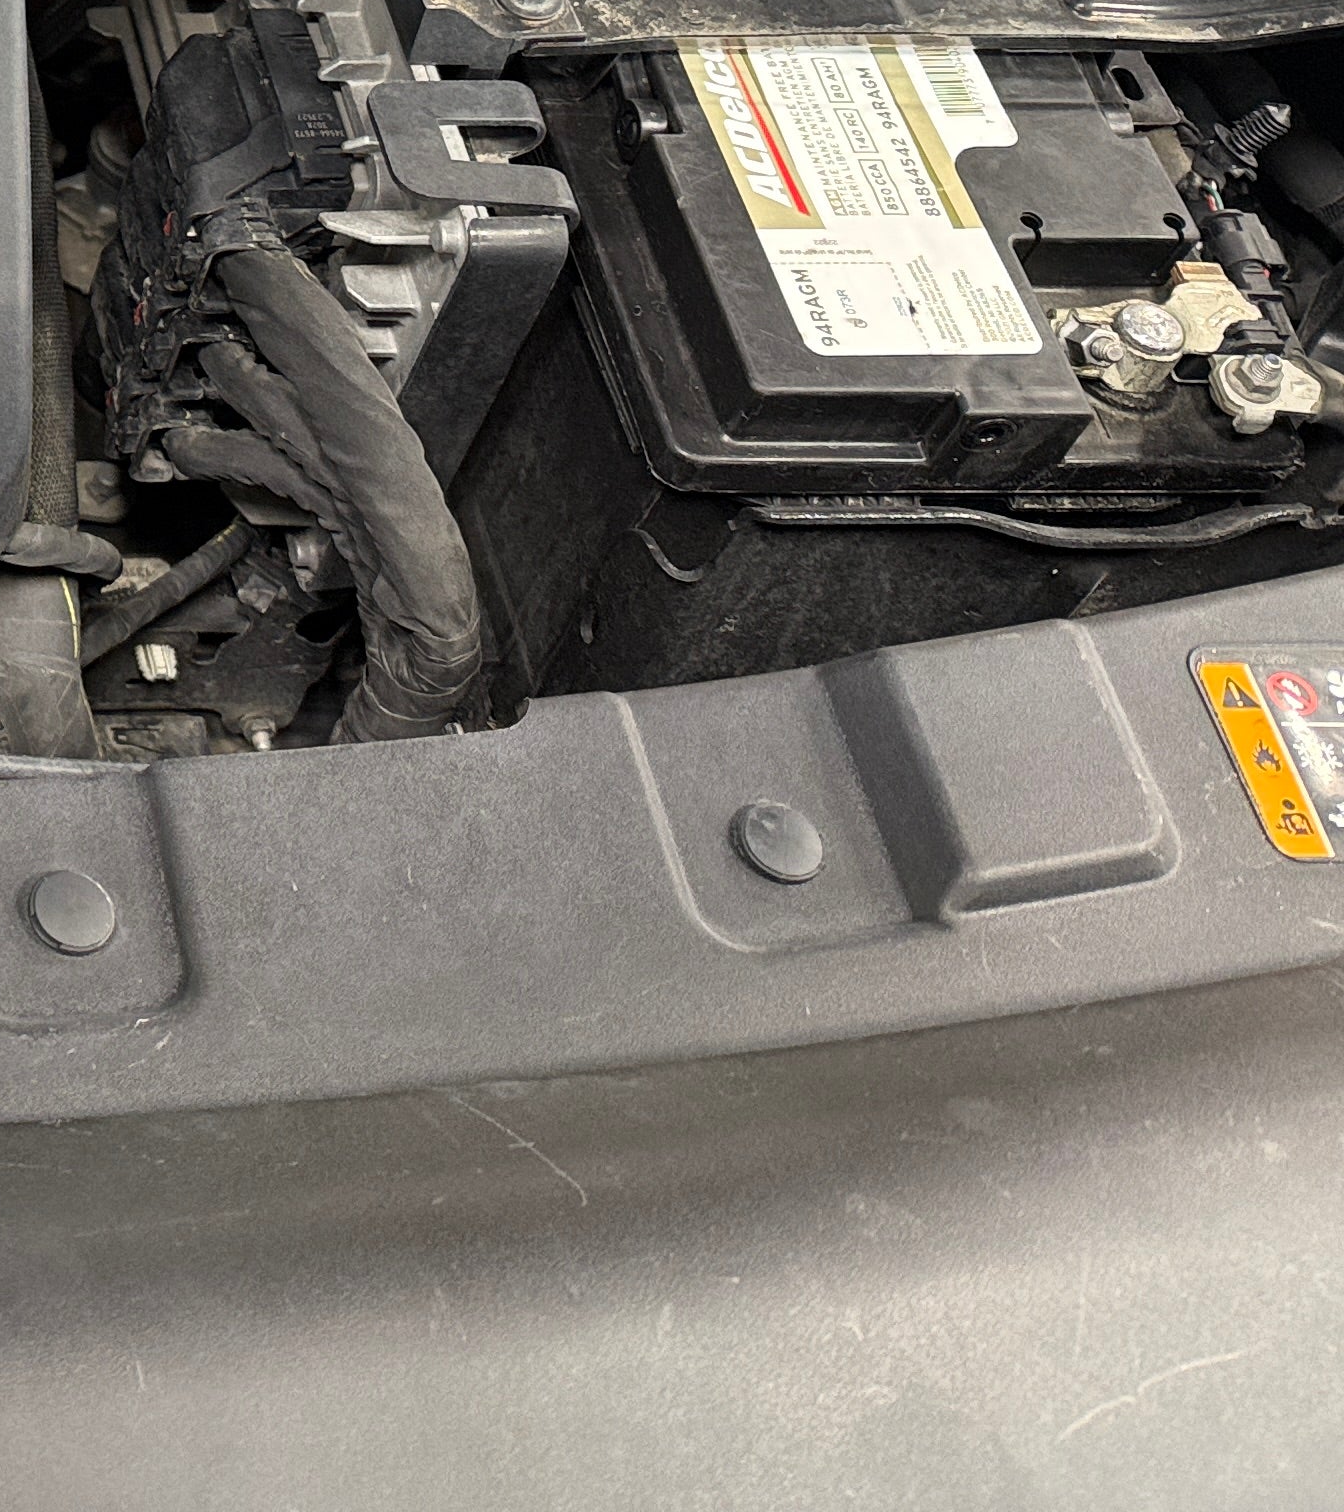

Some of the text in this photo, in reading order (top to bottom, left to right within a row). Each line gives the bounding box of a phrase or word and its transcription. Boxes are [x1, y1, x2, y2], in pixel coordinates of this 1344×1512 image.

[769, 70, 792, 99] FREE
[828, 84, 846, 98] 80
[778, 59, 859, 215] BATTERIE SANS ENTRETIEN AGM
[784, 102, 831, 185] MAINTENANCE
[820, 126, 836, 138] DE
[841, 111, 870, 149] 140 RC
[854, 66, 942, 216] 88864542 94RAGM
[828, 142, 851, 171] LIBRE
[865, 162, 900, 210] 850 CCA
[788, 268, 841, 346] 94RAGM
[834, 288, 857, 314] 073R
